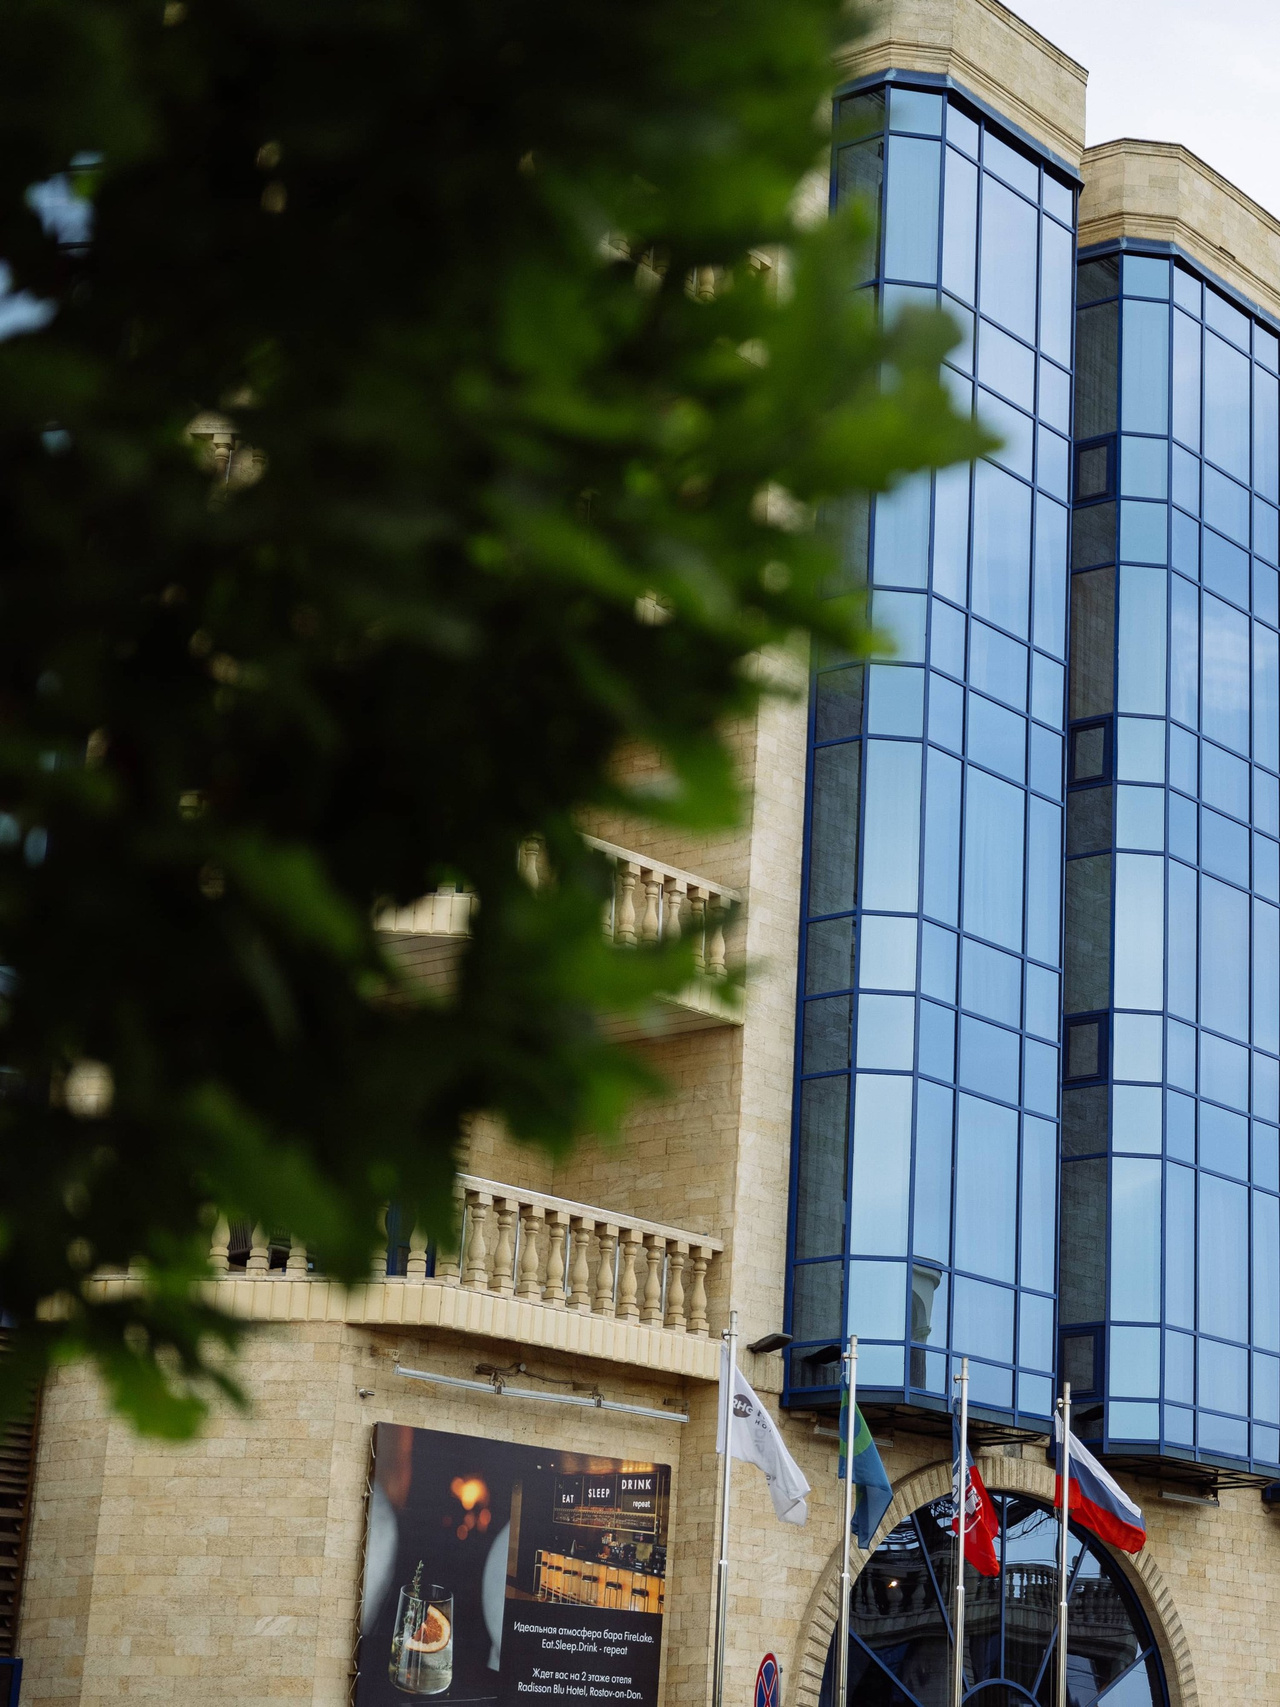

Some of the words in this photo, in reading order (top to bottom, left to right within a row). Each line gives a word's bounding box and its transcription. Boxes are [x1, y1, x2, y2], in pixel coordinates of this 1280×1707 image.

[754, 1419, 772, 1433] HO
[621, 1479, 652, 1490] DRINK
[562, 1494, 574, 1504] EAT
[588, 1488, 610, 1498] SLEEP
[632, 1500, 651, 1509] repeat
[513, 1621, 557, 1635] Идеальная
[558, 1627, 602, 1640] атмосфера
[603, 1629, 623, 1642] бара
[624, 1631, 655, 1644] FireLake.
[541, 1639, 598, 1654] Eat.Sleep.Drink
[603, 1646, 628, 1657] repeat
[532, 1667, 554, 1679] Ждет
[555, 1672, 569, 1680] вас
[570, 1673, 580, 1681] на
[581, 1671, 587, 1681] 2
[587, 1673, 610, 1683] этаже
[611, 1675, 632, 1685] отеля
[517, 1681, 552, 1694] Radisson
[553, 1683, 565, 1695] Blu
[566, 1685, 588, 1697] Hotel,
[589, 1687, 643, 1700] Rostov-on-Don.
